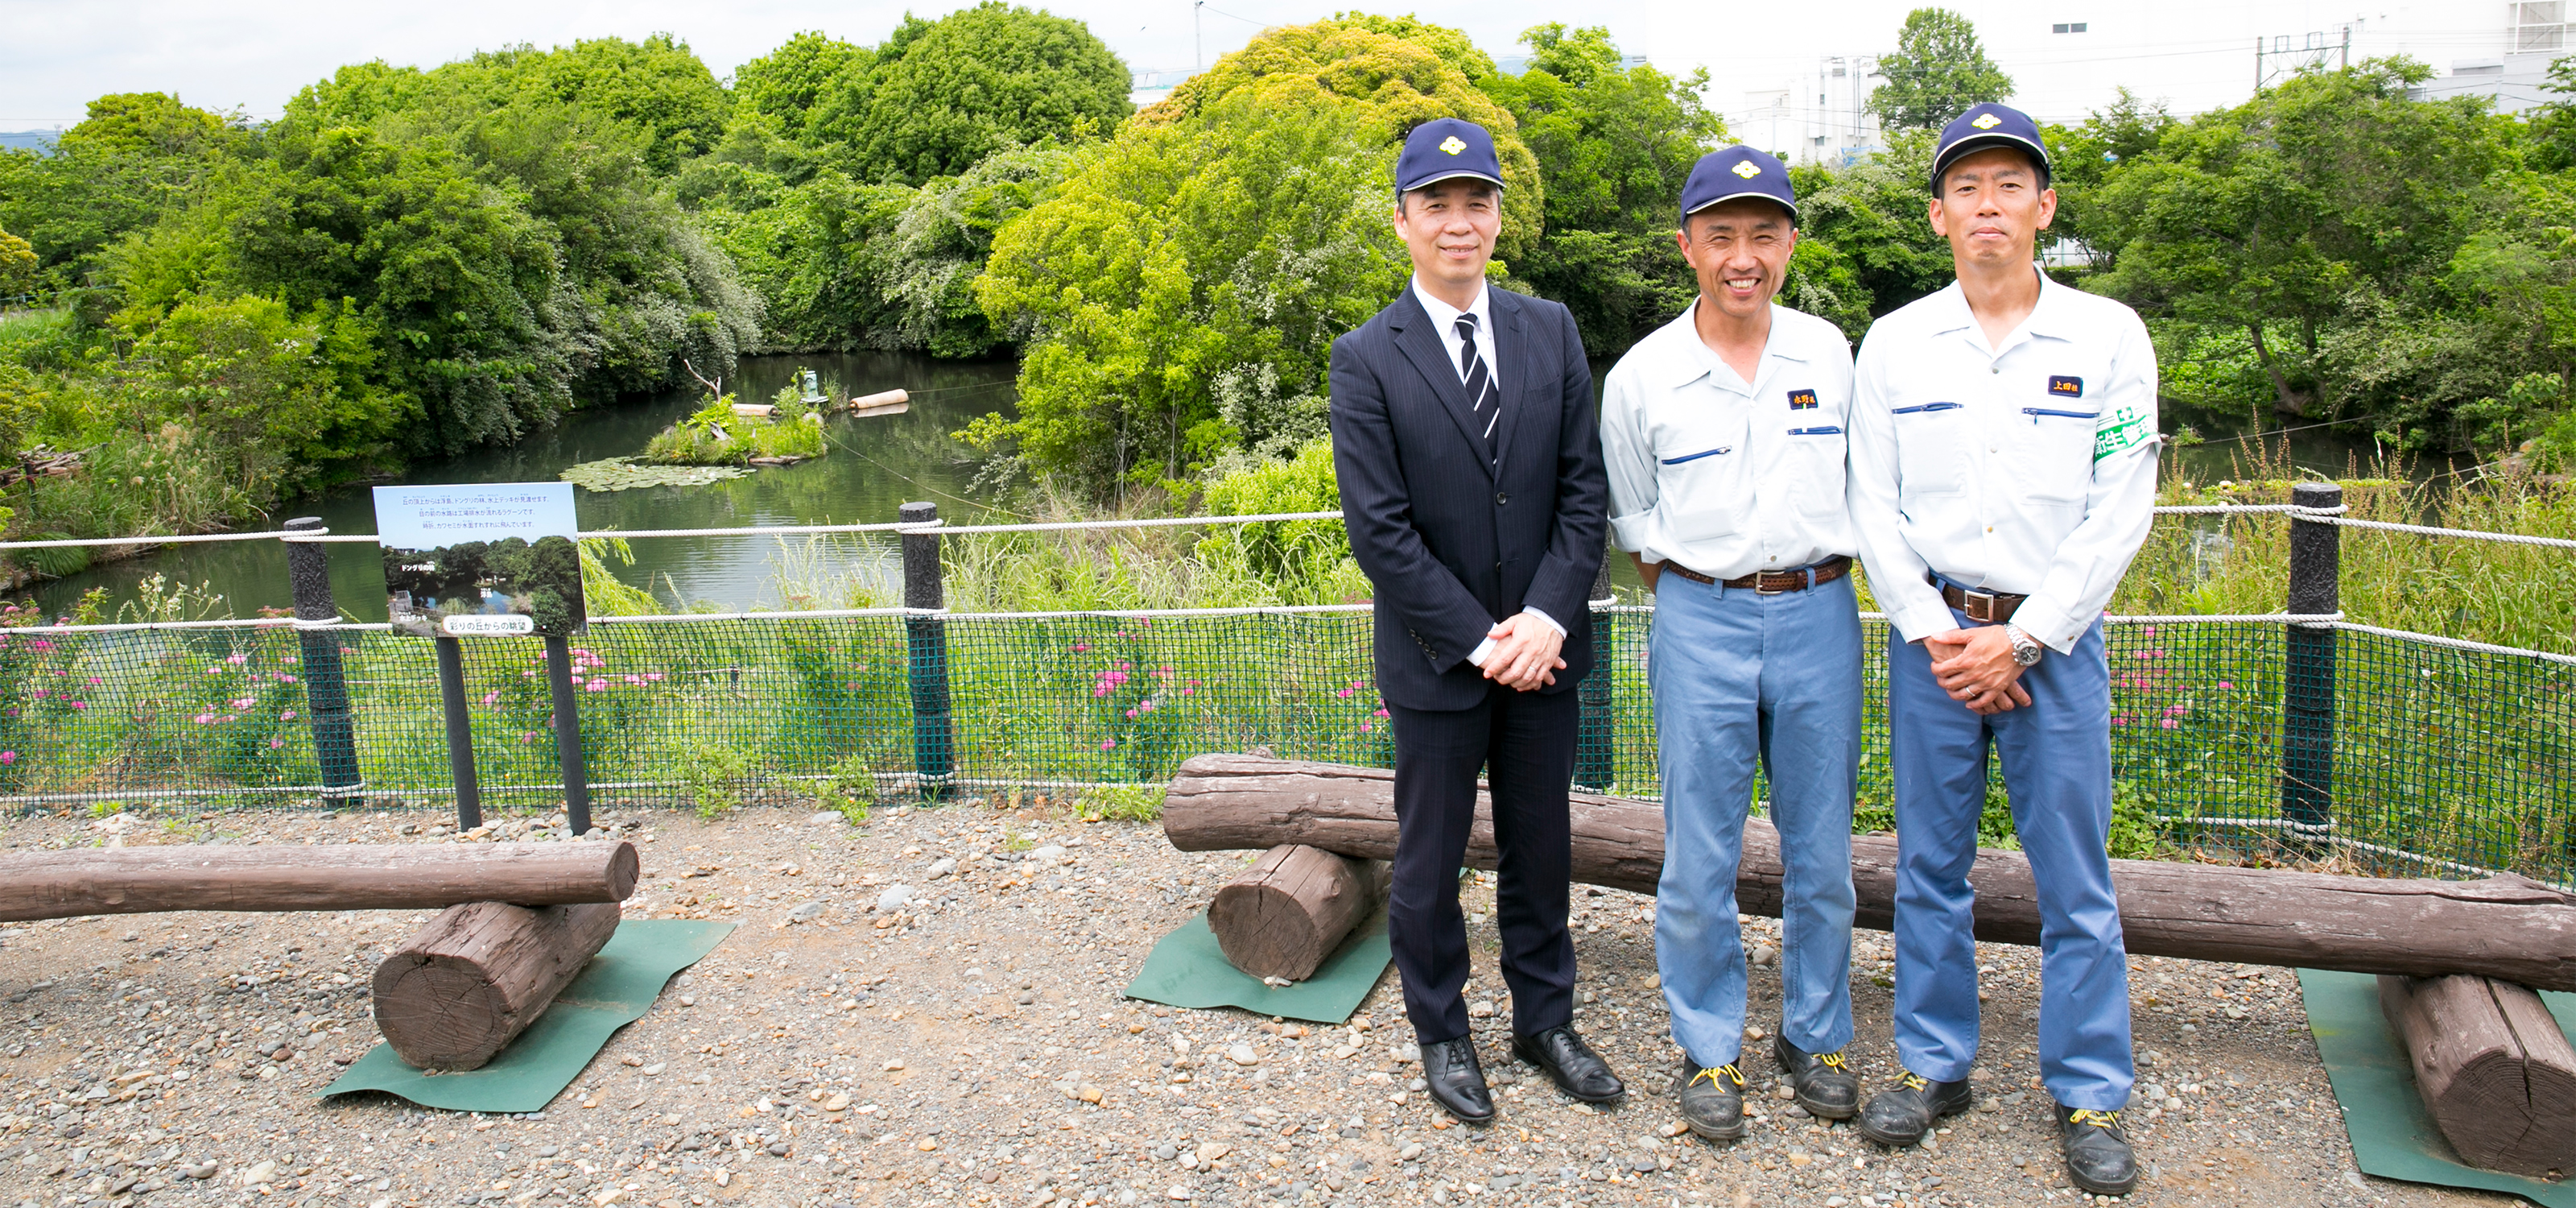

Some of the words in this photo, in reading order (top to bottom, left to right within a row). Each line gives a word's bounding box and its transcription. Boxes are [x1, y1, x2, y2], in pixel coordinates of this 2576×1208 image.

[450, 622, 526, 631] 彩りの丘からの眺望
